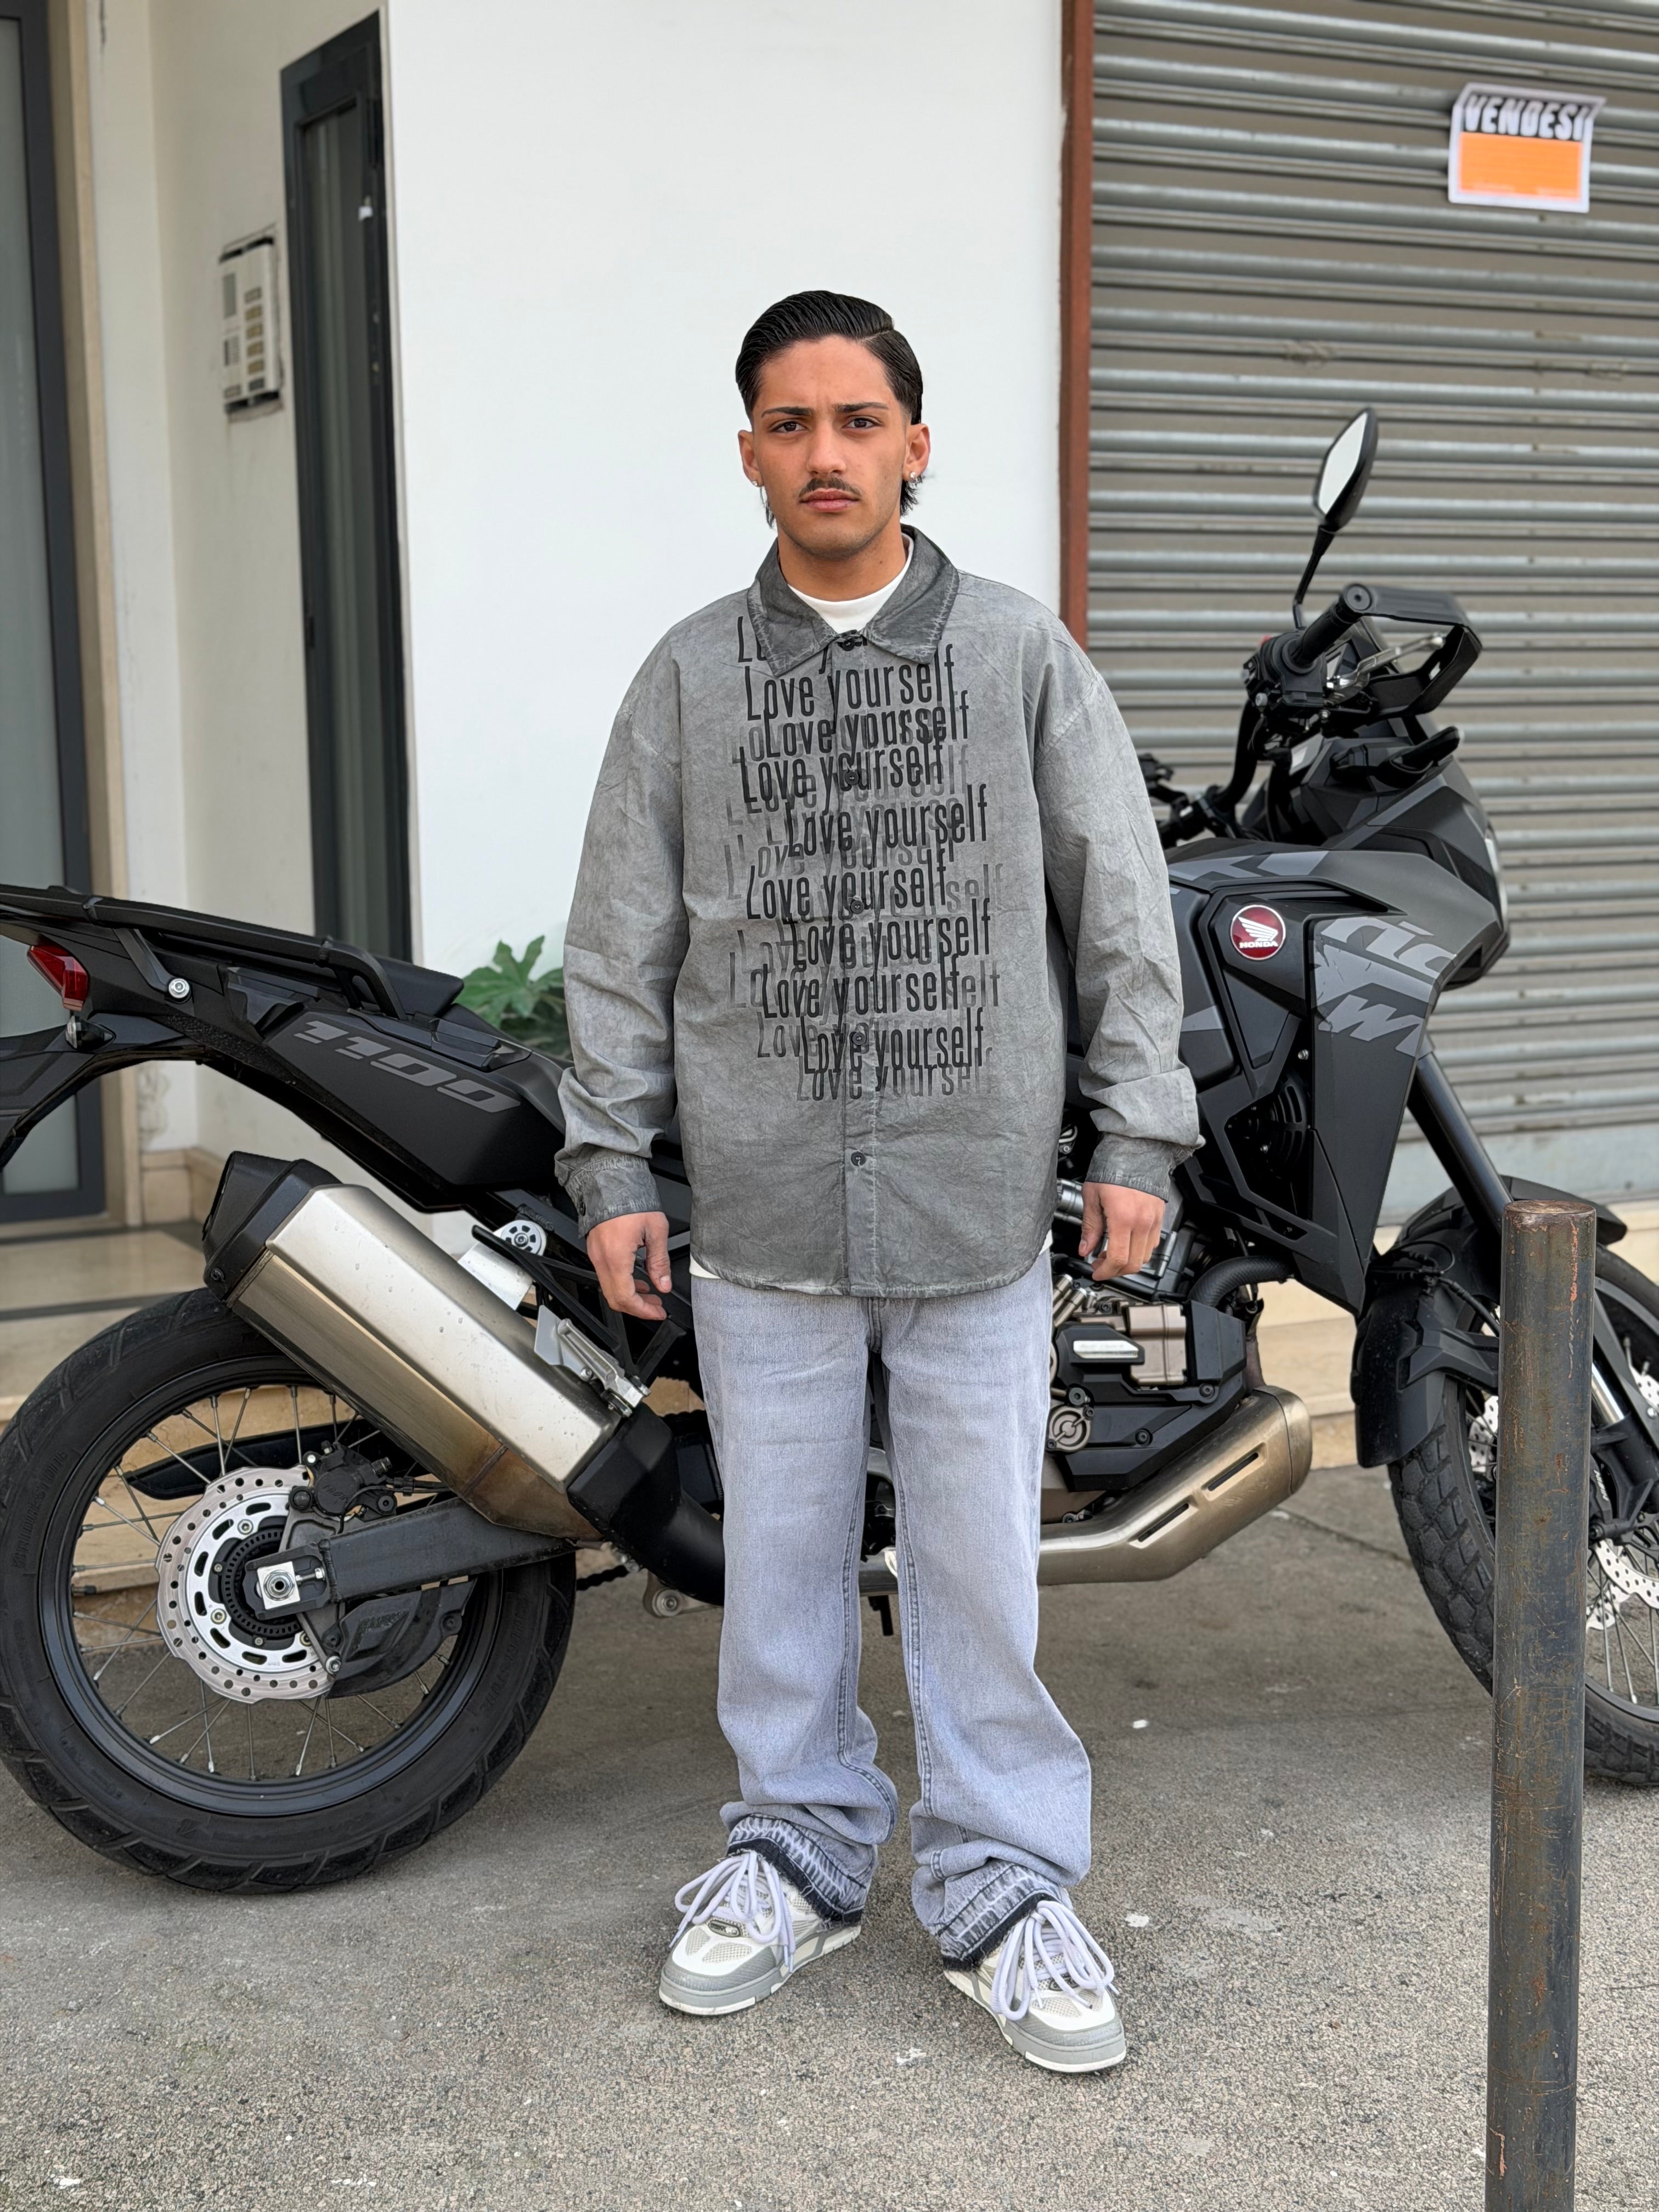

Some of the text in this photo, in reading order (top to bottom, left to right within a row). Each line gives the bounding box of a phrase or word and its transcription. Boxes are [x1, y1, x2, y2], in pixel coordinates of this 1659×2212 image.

[1464, 94, 1589, 142] VENDESI
[745, 665, 815, 720] Love
[827, 644, 955, 735] yourself
[763, 709, 832, 758] Love
[844, 690, 969, 766] yourself
[739, 746, 806, 803] Love
[820, 735, 944, 816] yourself
[786, 802, 852, 857] Love
[865, 783, 988, 870] yourself
[747, 865, 810, 919] Love
[822, 848, 946, 927] yourself
[790, 912, 855, 966] Love
[868, 898, 991, 978] yourself
[1239, 940, 1279, 949] HONDA
[761, 963, 820, 1019] Love
[833, 953, 960, 1036] yourself
[294, 1020, 521, 1113] 1100
[797, 1056, 862, 1101] Love
[800, 1017, 862, 1074] Love
[874, 1007, 984, 1092] yourself
